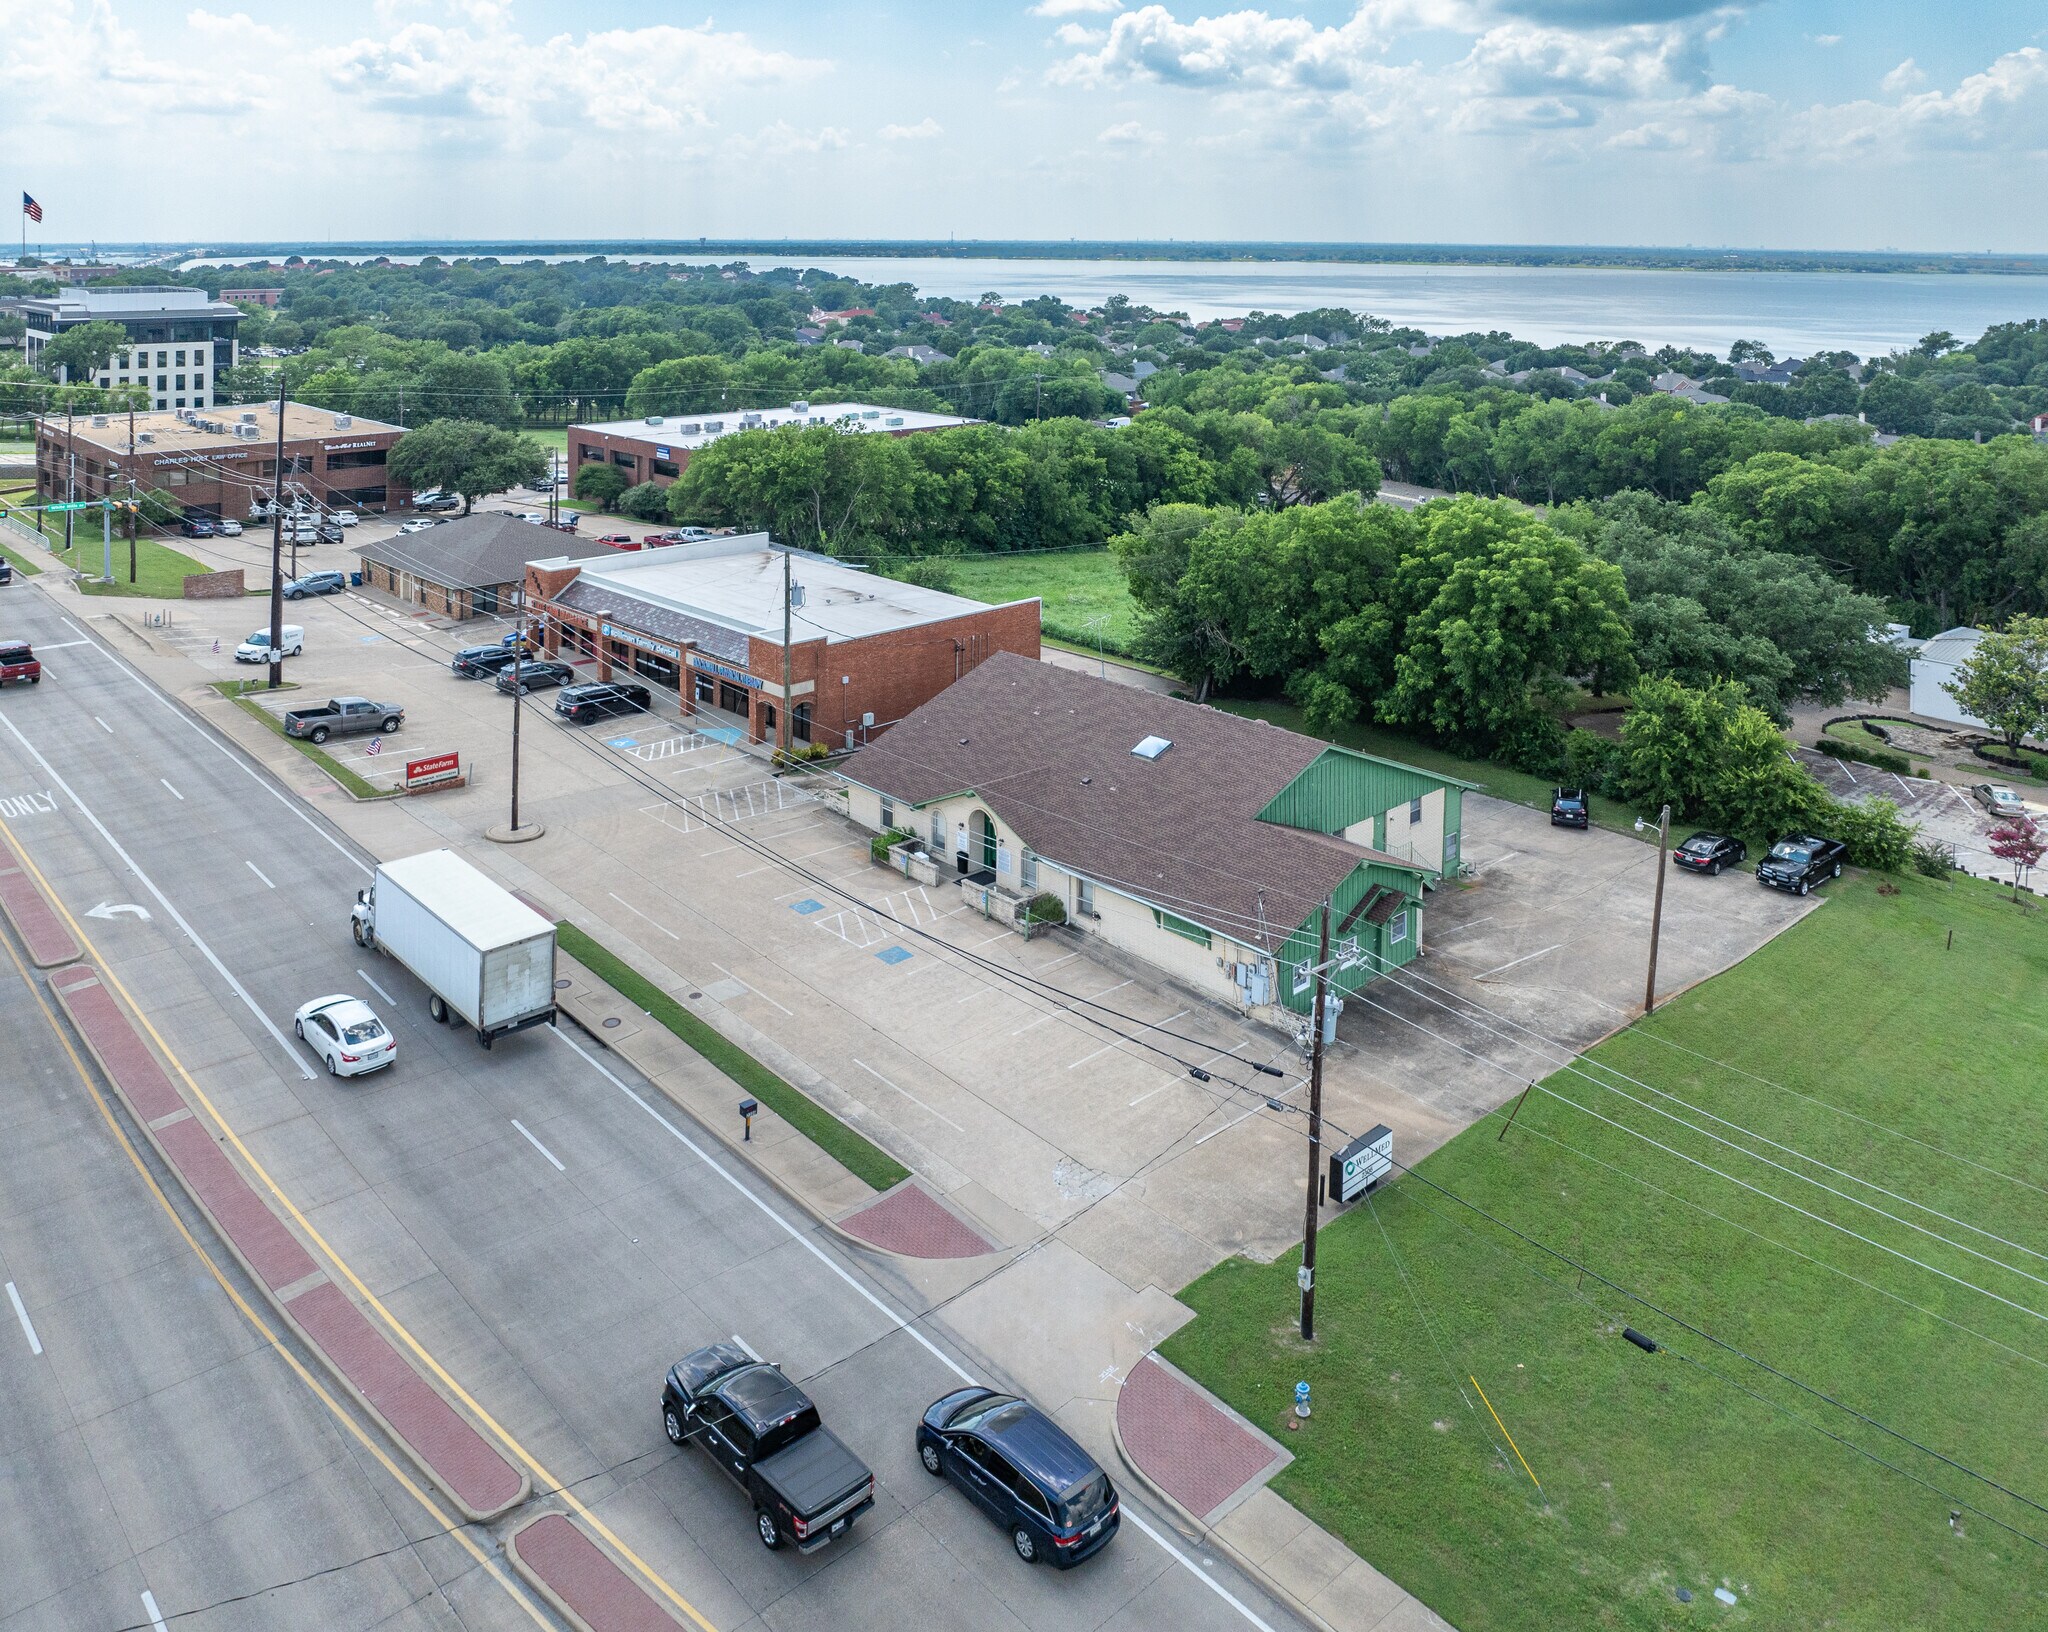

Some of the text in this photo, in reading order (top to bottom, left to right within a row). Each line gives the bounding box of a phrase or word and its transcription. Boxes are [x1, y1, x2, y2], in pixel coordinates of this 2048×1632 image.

[154, 457, 188, 466] CHARLES
[190, 455, 209, 463] HOLT
[0, 790, 58, 817] ONLY
